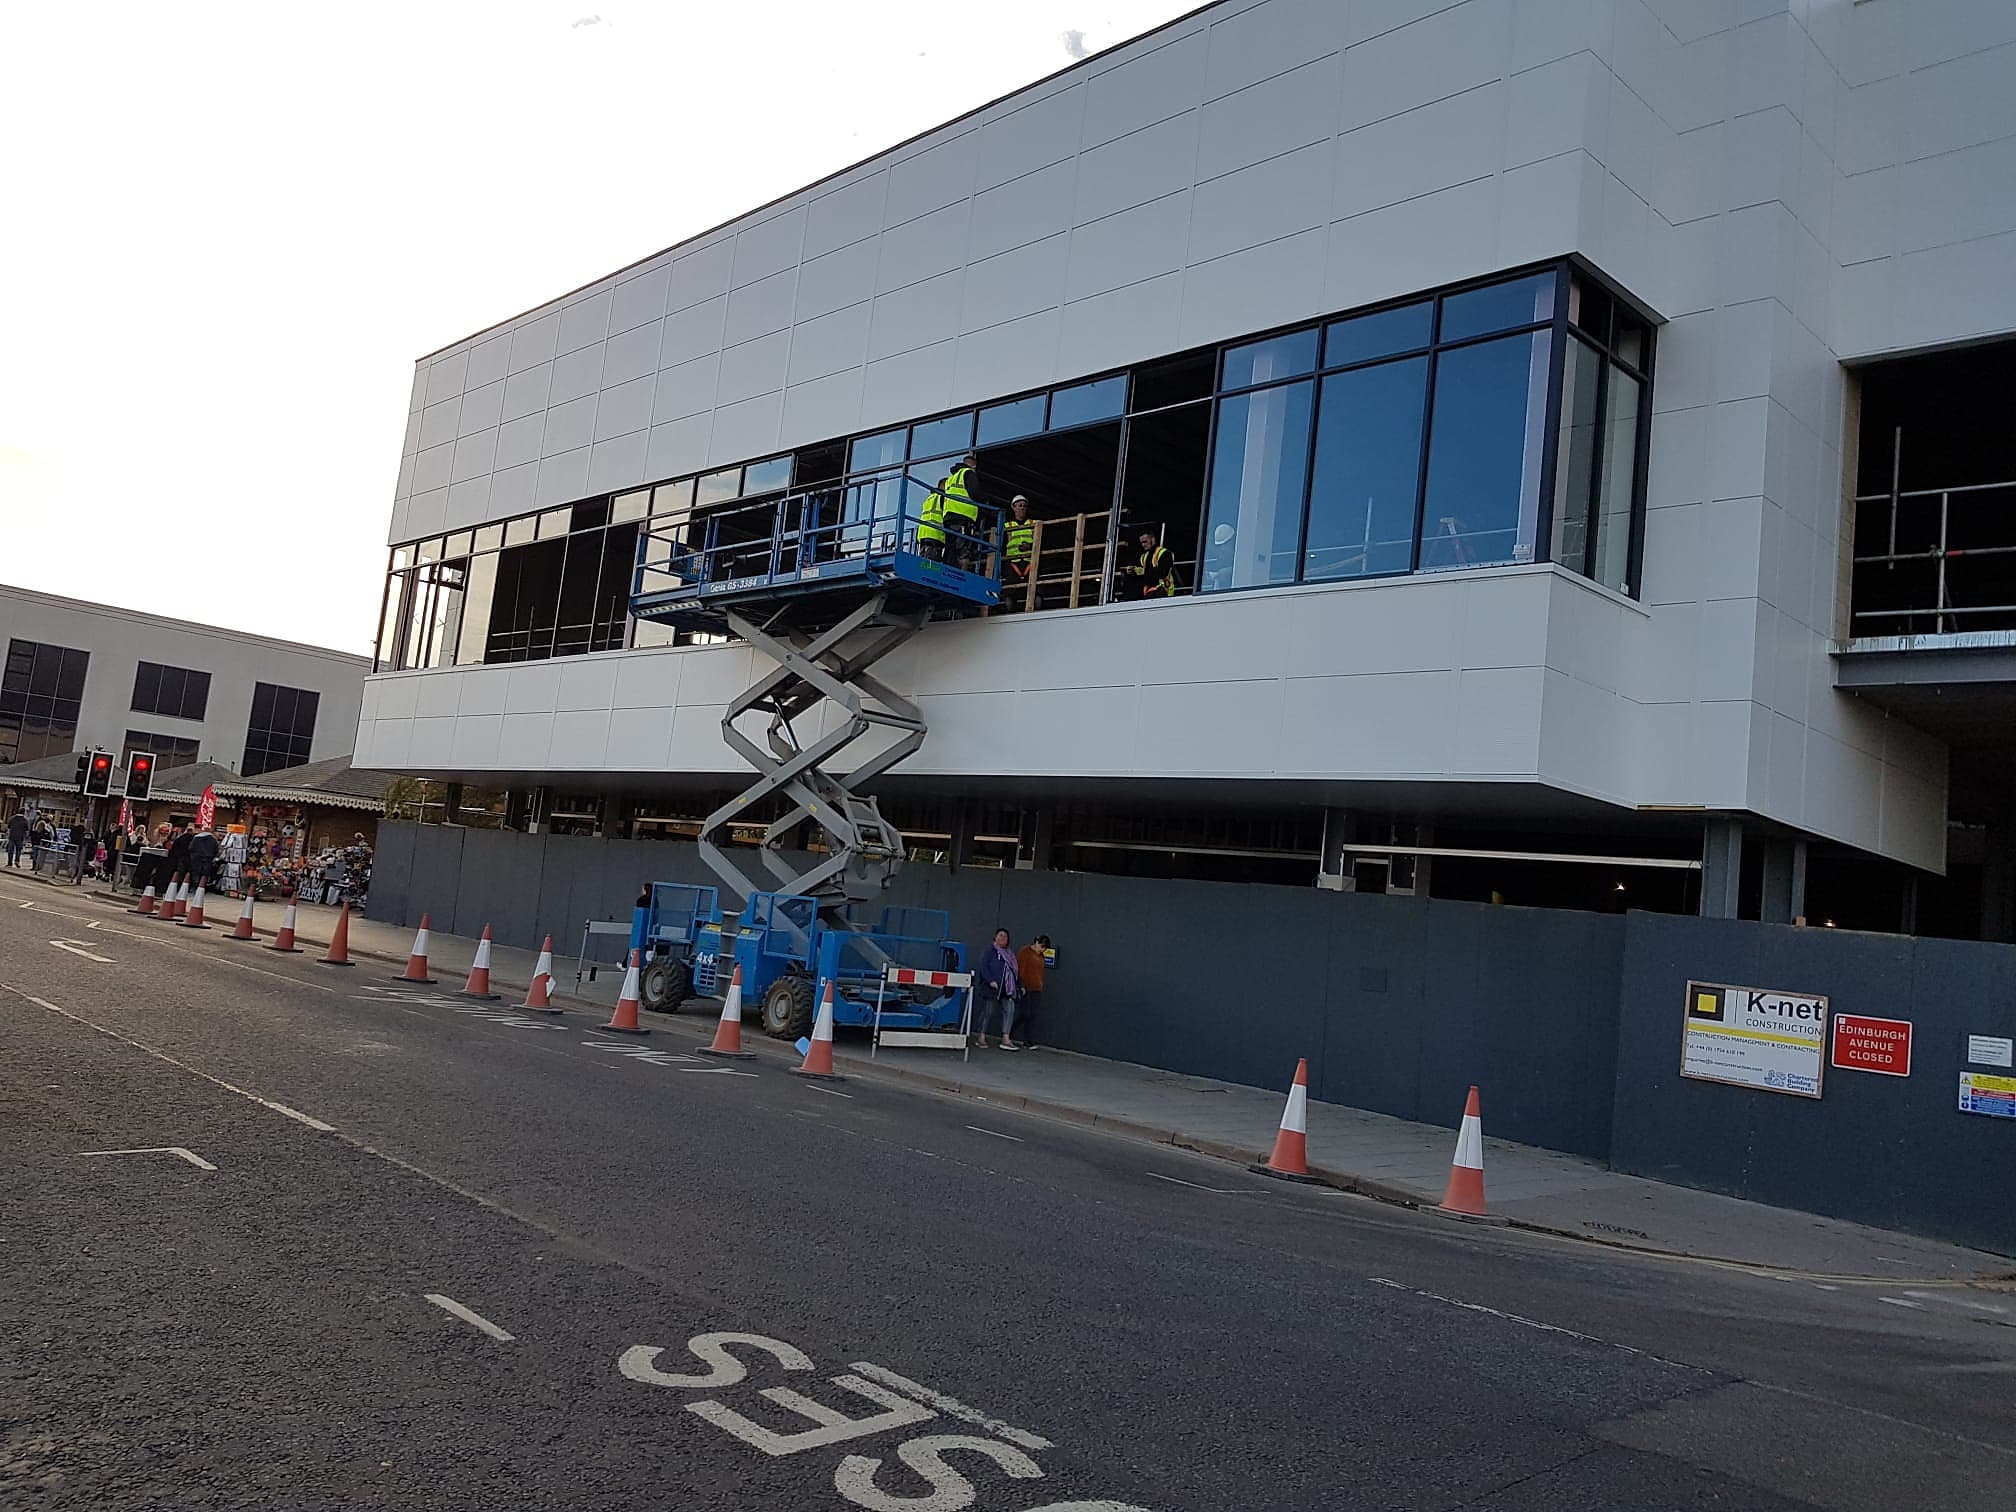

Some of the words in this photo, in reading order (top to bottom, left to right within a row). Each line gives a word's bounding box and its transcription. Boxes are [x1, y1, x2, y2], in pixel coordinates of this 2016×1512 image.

[696, 951, 714, 965] 4x4
[1747, 991, 1822, 1021] K-net
[1745, 1018, 1821, 1036] CONSTRUCTION
[1839, 1024, 1906, 1040] EDINBURGH
[1687, 1030, 1731, 1041] CONSTRUCTION
[1731, 1036, 1770, 1047] MANAGEMENT
[1849, 1038, 1895, 1052] AVENUE
[1848, 1050, 1893, 1064] CLOSED
